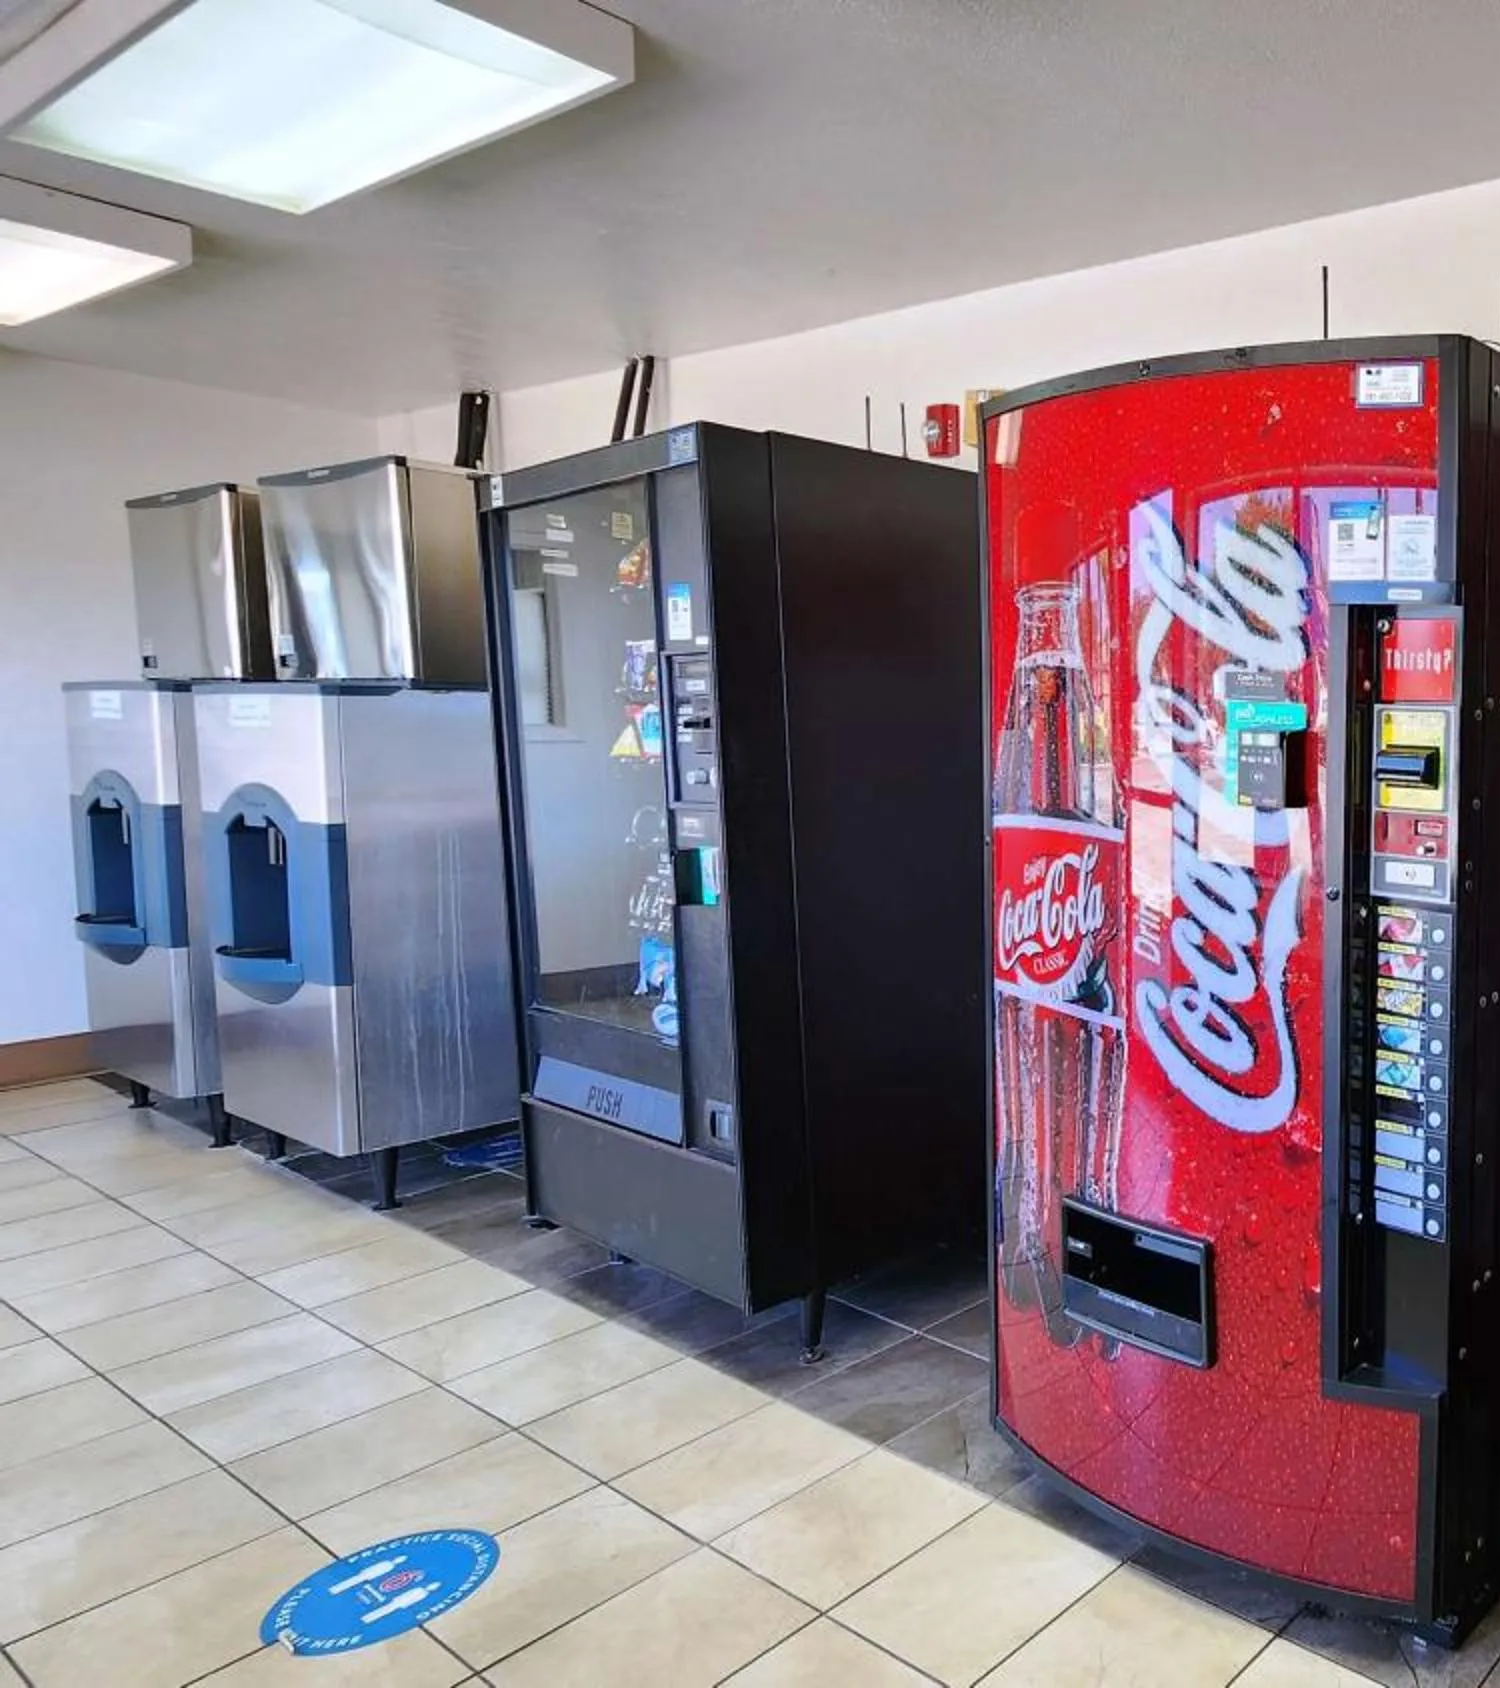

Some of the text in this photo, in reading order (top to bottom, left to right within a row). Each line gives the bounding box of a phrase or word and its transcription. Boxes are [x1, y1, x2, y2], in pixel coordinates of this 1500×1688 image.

[1385, 648, 1452, 672] Thirsty?
[1136, 500, 1306, 1132] Coca-Cla
[999, 843, 1105, 971] Coca-Cola
[586, 1085, 624, 1119] PUSH
[309, 1633, 364, 1649] HERE
